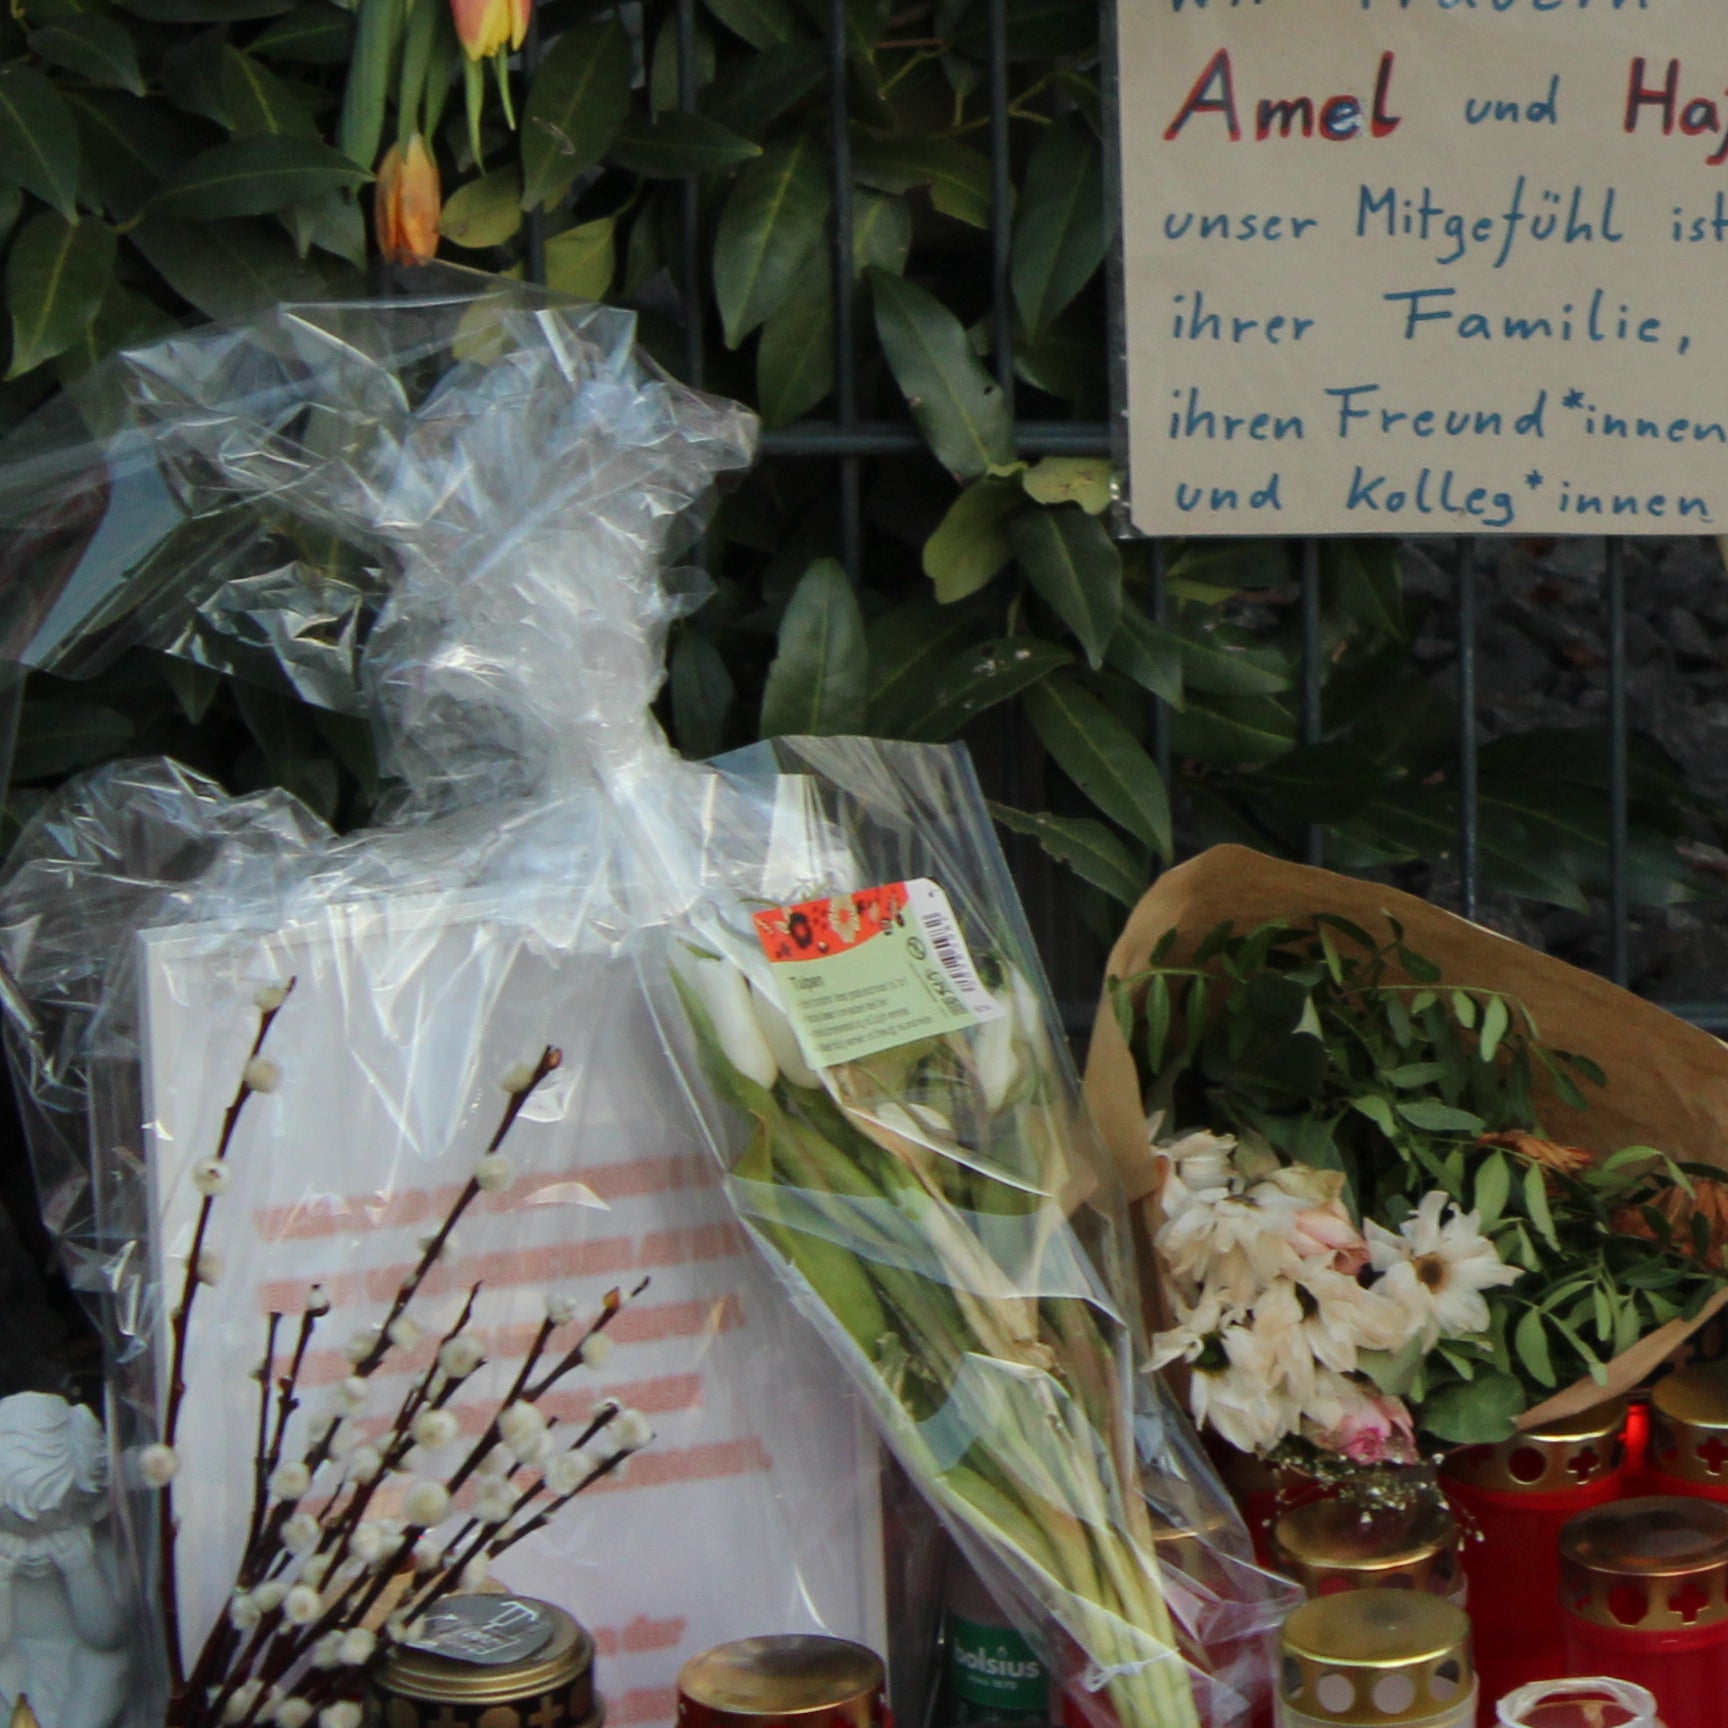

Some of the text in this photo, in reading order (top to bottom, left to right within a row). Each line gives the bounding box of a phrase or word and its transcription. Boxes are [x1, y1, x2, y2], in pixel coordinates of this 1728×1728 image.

[1163, 48, 1401, 143] Amel
[1464, 75, 1560, 125] und
[1164, 211, 1318, 243] unser
[1356, 175, 1624, 268] Mitgefühl
[1172, 286, 1691, 354] ihrer Familie,
[1169, 386, 1306, 441] ihren
[1175, 473, 1283, 512] und
